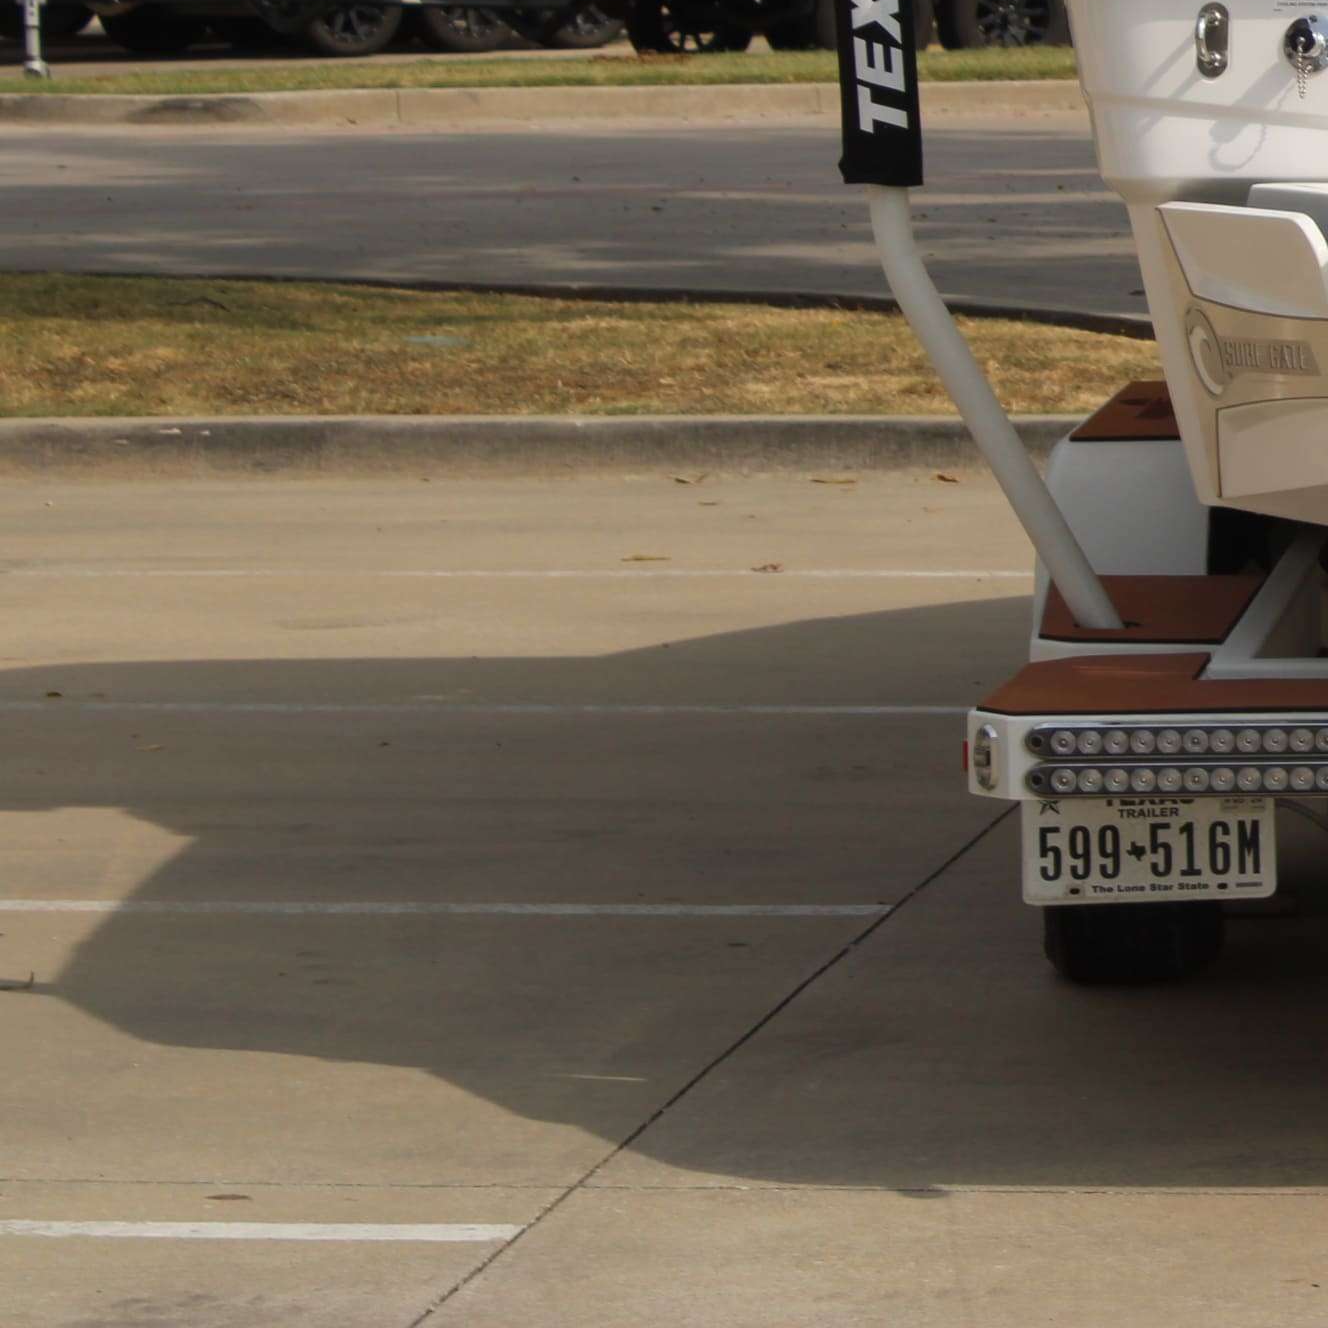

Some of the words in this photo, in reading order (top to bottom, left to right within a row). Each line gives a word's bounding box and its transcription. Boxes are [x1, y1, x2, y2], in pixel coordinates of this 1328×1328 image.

[1117, 807, 1180, 819] TRAILER
[1039, 824, 1121, 882] 599
[1150, 819, 1262, 878] 516M
[1092, 884, 1114, 893] The
[1117, 884, 1146, 893] Lone
[1150, 883, 1174, 892] Star
[1178, 881, 1209, 891] State
